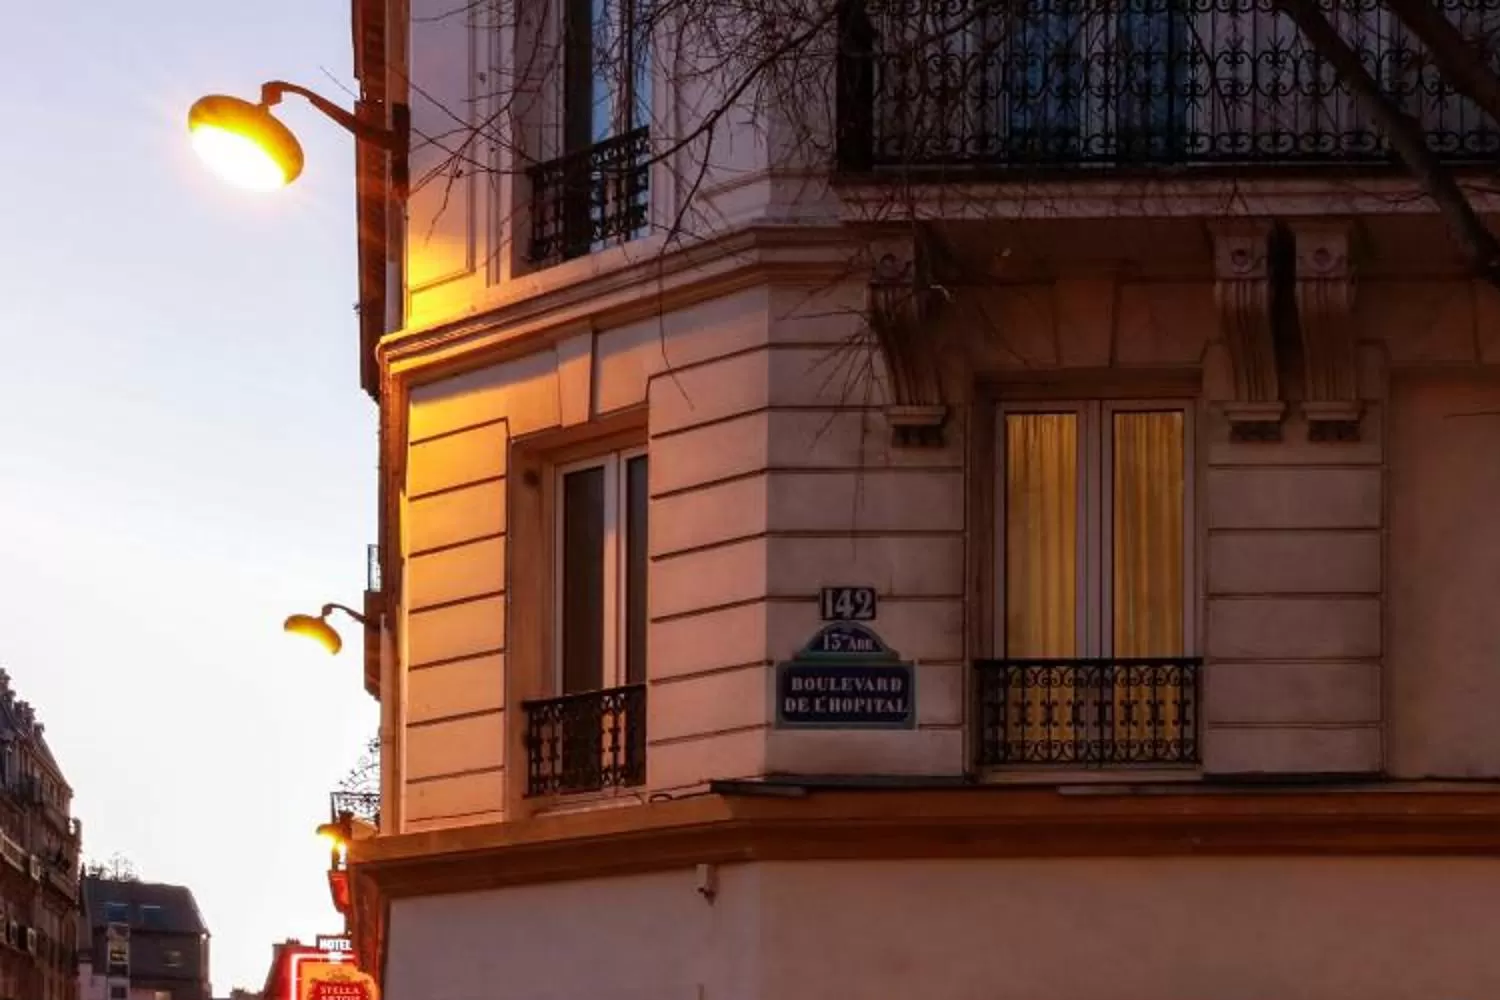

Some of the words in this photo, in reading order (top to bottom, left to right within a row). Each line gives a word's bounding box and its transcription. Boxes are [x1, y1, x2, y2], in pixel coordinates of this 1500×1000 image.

[824, 589, 874, 619] 142
[791, 676, 903, 692] BOULEVARD
[784, 697, 810, 713] DE
[319, 938, 353, 951] HOTEL
[319, 986, 361, 995] STELLA
